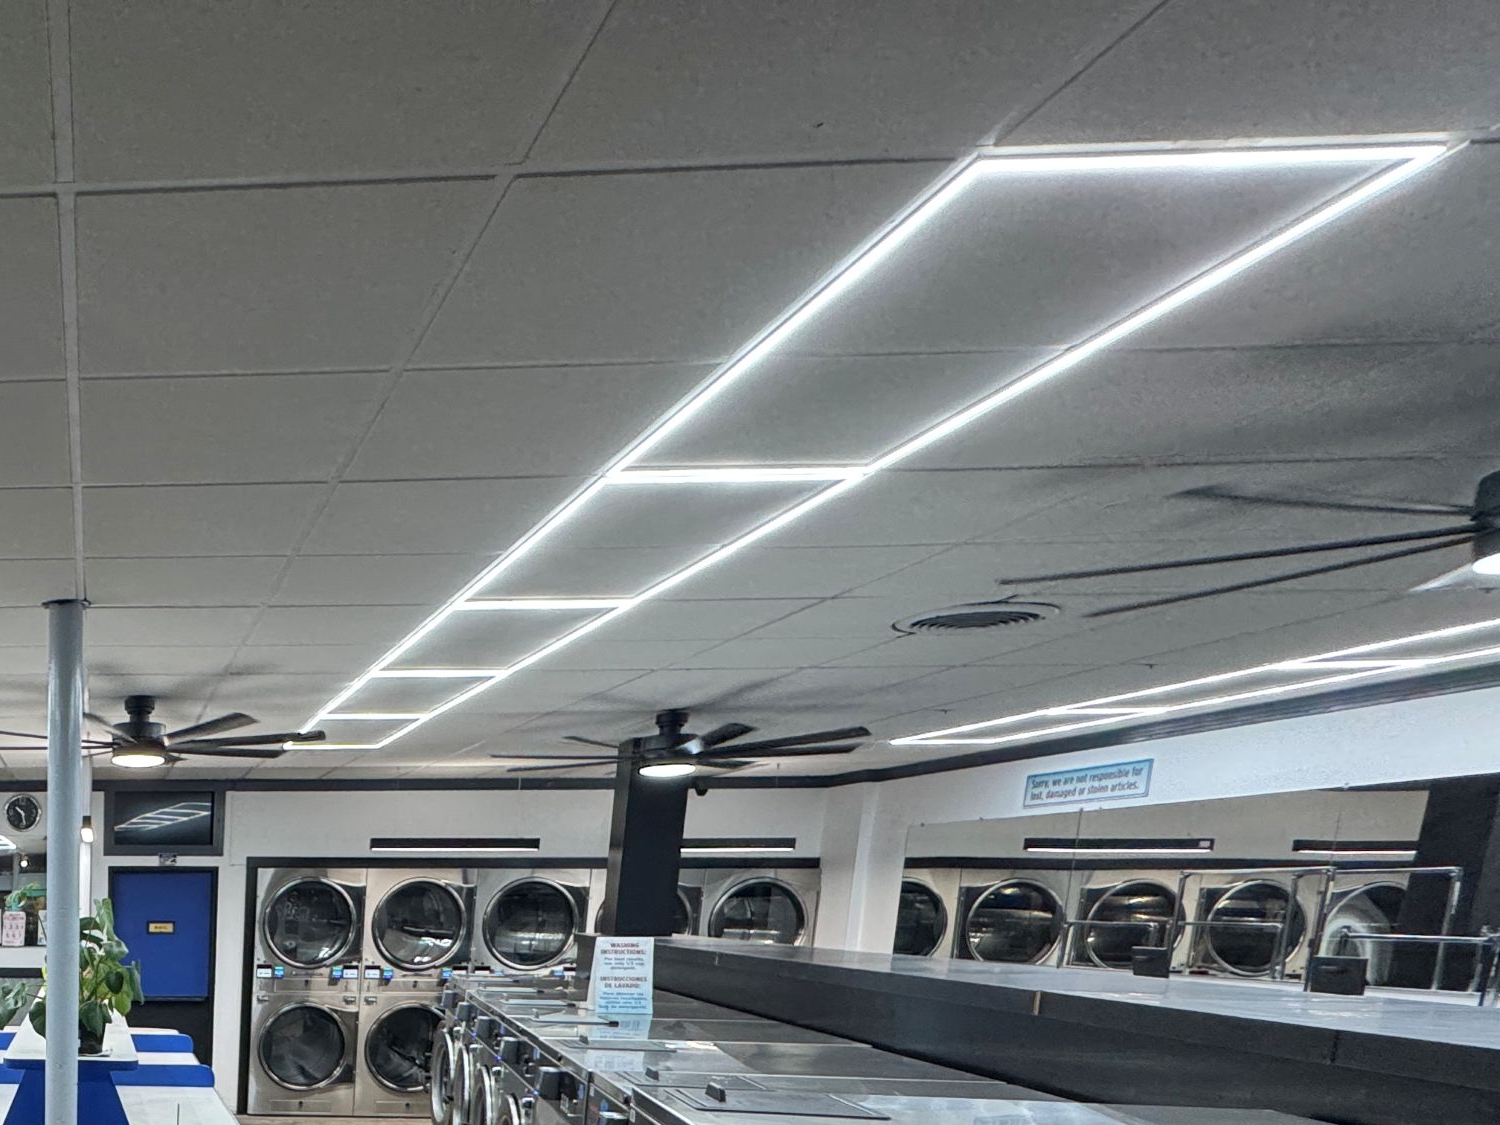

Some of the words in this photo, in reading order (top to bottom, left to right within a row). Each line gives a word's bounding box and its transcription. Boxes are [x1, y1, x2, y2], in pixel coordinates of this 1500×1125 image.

[1031, 778, 1049, 790] Sorry,
[1052, 778, 1062, 787] we
[1063, 776, 1074, 785] are
[1076, 774, 1088, 783] not
[1089, 768, 1130, 782] responsible
[1132, 766, 1143, 777] for
[1030, 791, 1044, 801] lost,
[1045, 787, 1076, 799] damaged
[1078, 787, 1086, 796] or
[1087, 784, 1109, 796] stolen
[1110, 780, 1139, 792] articles.
